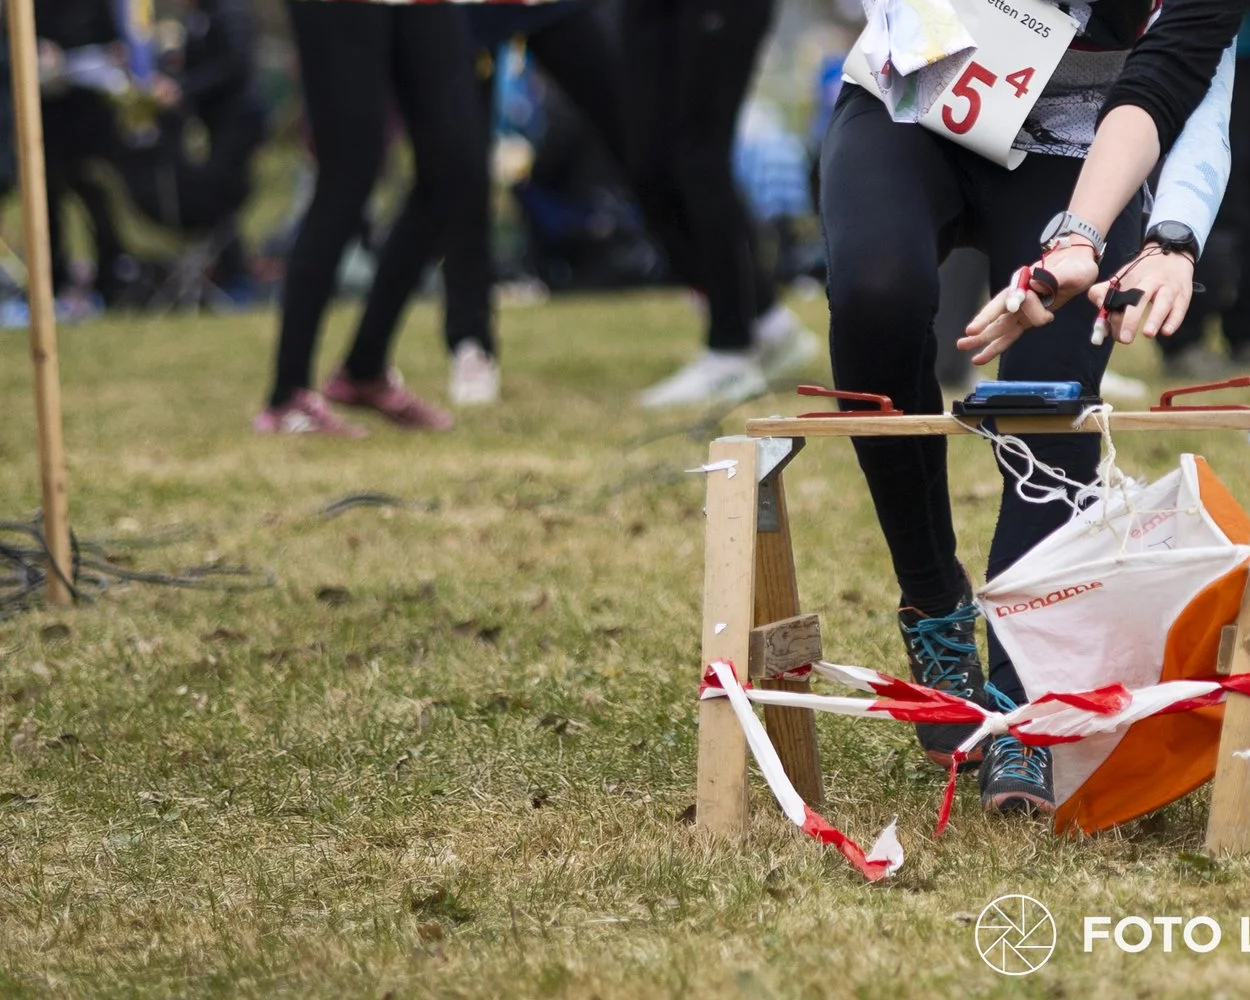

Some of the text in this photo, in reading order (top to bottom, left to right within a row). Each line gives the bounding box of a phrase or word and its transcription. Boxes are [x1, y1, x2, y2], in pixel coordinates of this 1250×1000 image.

[1020, 13, 1052, 40] 2025
[942, 60, 1036, 135] 5 4
[995, 581, 1103, 618] noname
